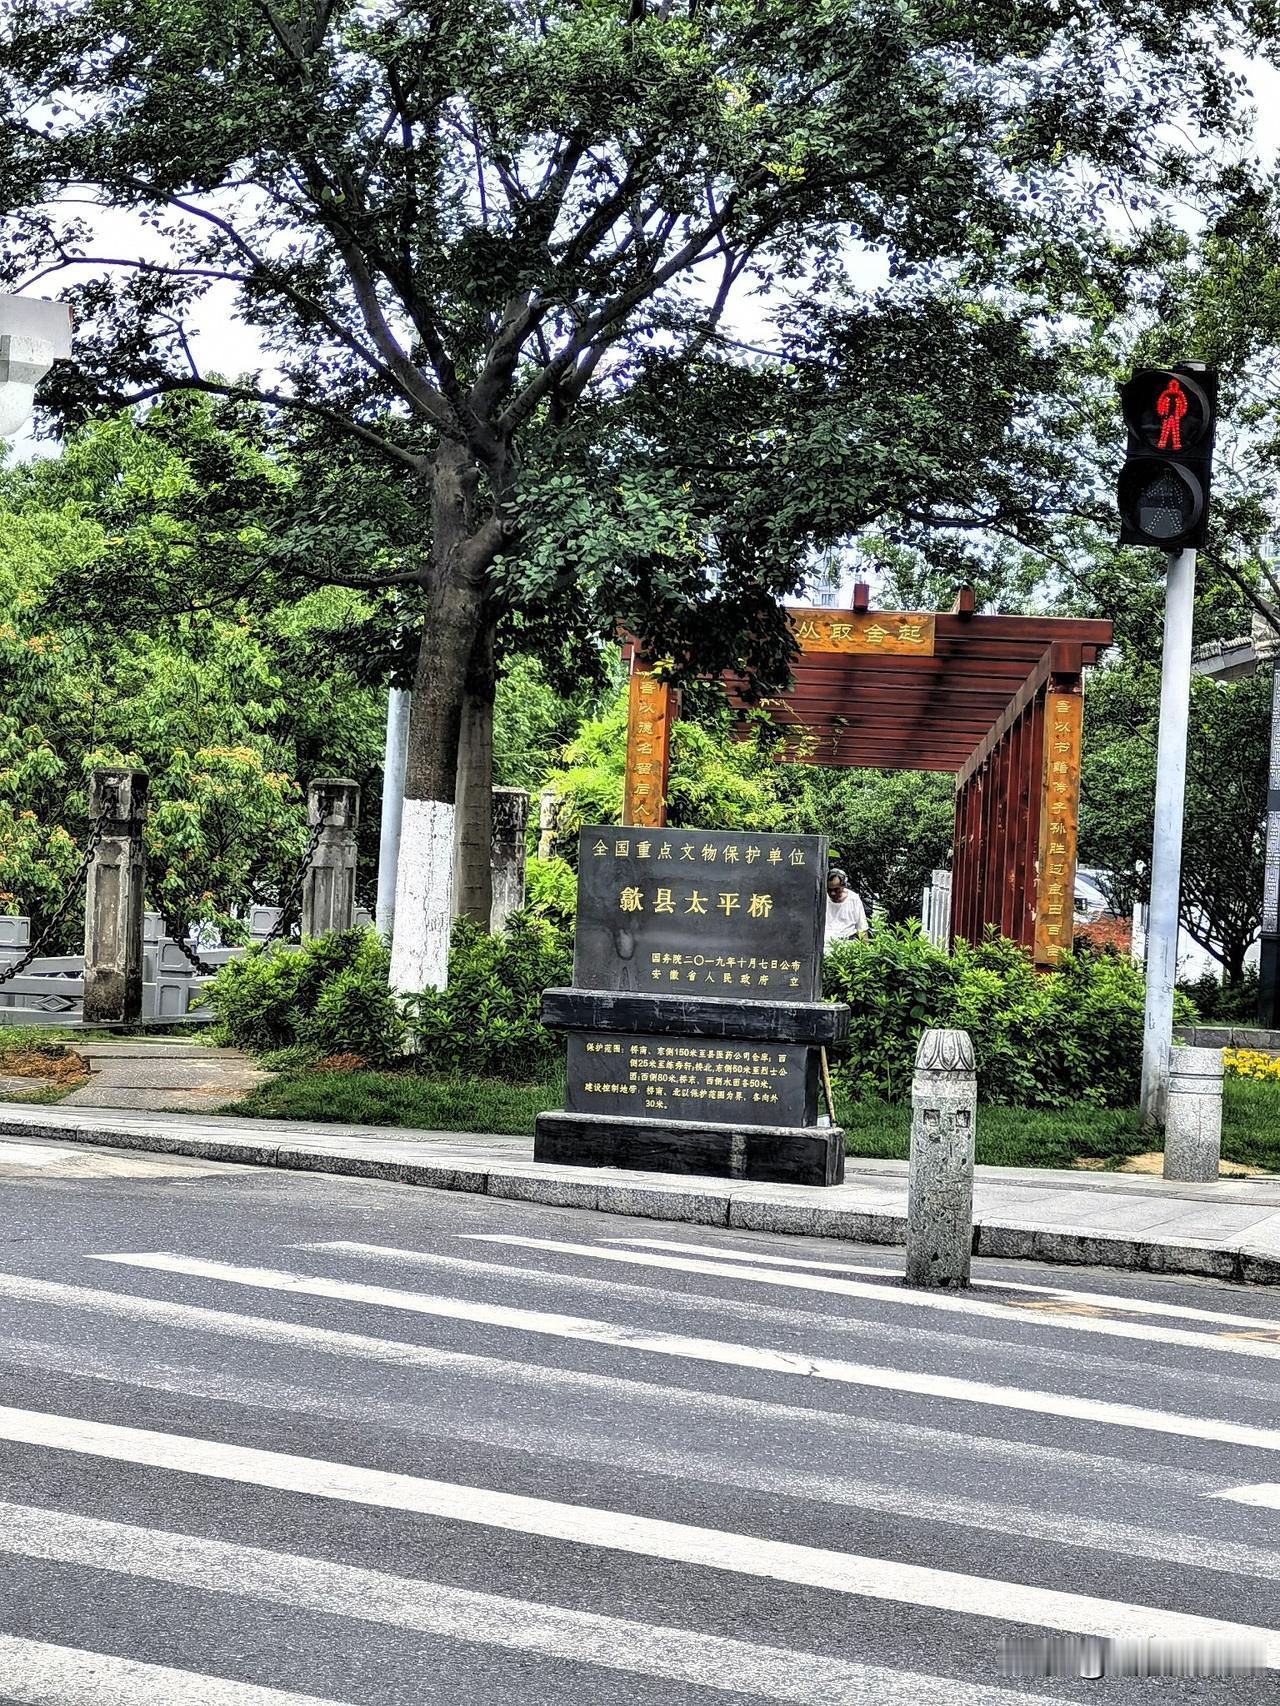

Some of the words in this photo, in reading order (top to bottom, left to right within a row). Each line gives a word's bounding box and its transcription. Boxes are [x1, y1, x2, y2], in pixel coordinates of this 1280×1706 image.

[633, 681, 657, 827] 吾以德名留后人
[592, 839, 806, 866] 全国重点文物保护单位
[619, 886, 774, 918] 歙县太平桥
